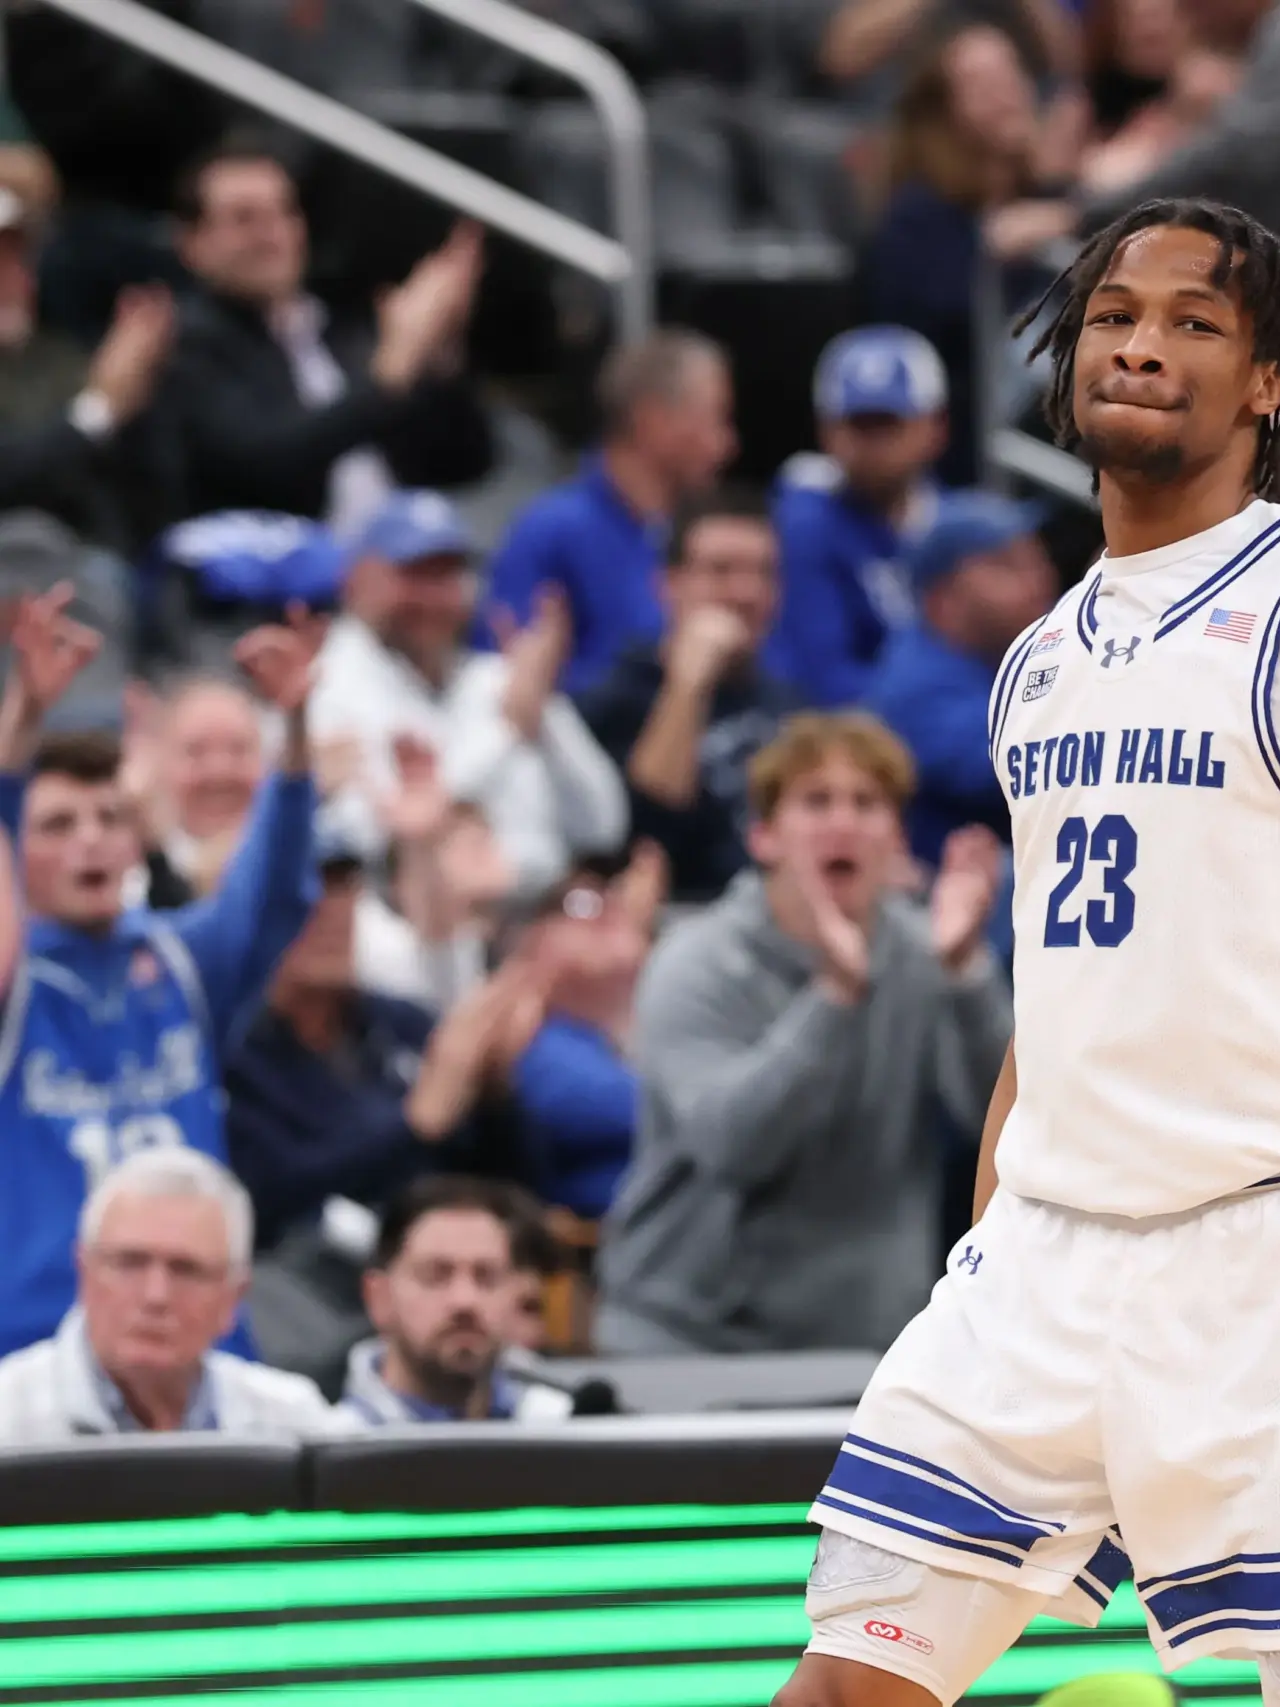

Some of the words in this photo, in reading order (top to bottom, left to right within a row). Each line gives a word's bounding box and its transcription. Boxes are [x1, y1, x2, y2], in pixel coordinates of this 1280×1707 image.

[1032, 637, 1066, 654] EAST
[1038, 628, 1064, 644] BIG
[1028, 671, 1044, 687] BE
[1043, 667, 1058, 683] THE
[1007, 731, 1105, 800] SETON
[1115, 728, 1225, 788] HALL
[1043, 814, 1138, 948] 23
